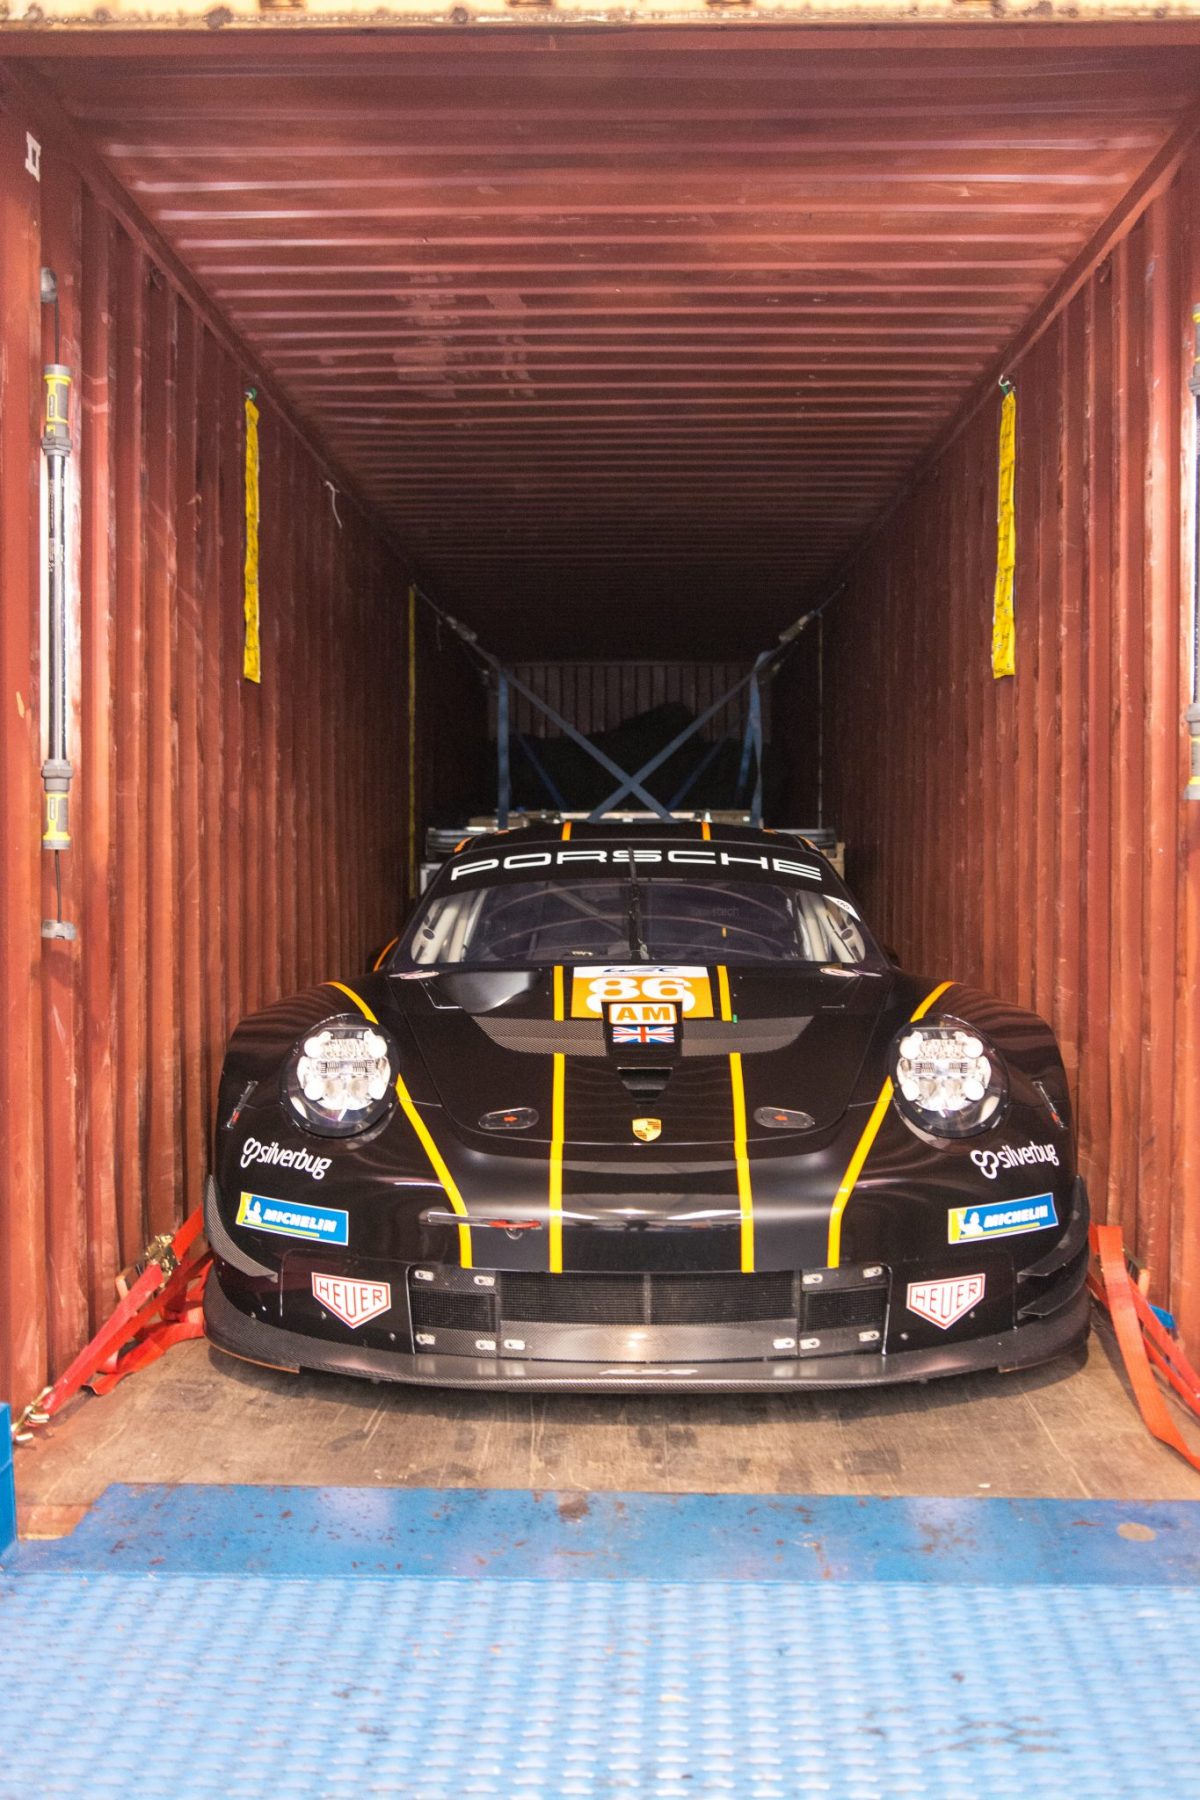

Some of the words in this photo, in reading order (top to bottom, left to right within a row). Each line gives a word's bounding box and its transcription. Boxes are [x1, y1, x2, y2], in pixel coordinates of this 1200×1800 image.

[451, 849, 823, 881] PORSCHE
[586, 977, 696, 1014] 86
[616, 1006, 671, 1021] AM
[256, 1141, 333, 1180] silverbug
[998, 1140, 1060, 1170] silverbug
[262, 1208, 338, 1233] MICHELIN
[982, 1204, 1049, 1229] MICHELIN
[318, 1281, 384, 1319] HEUER
[914, 1281, 979, 1319] HEUER
